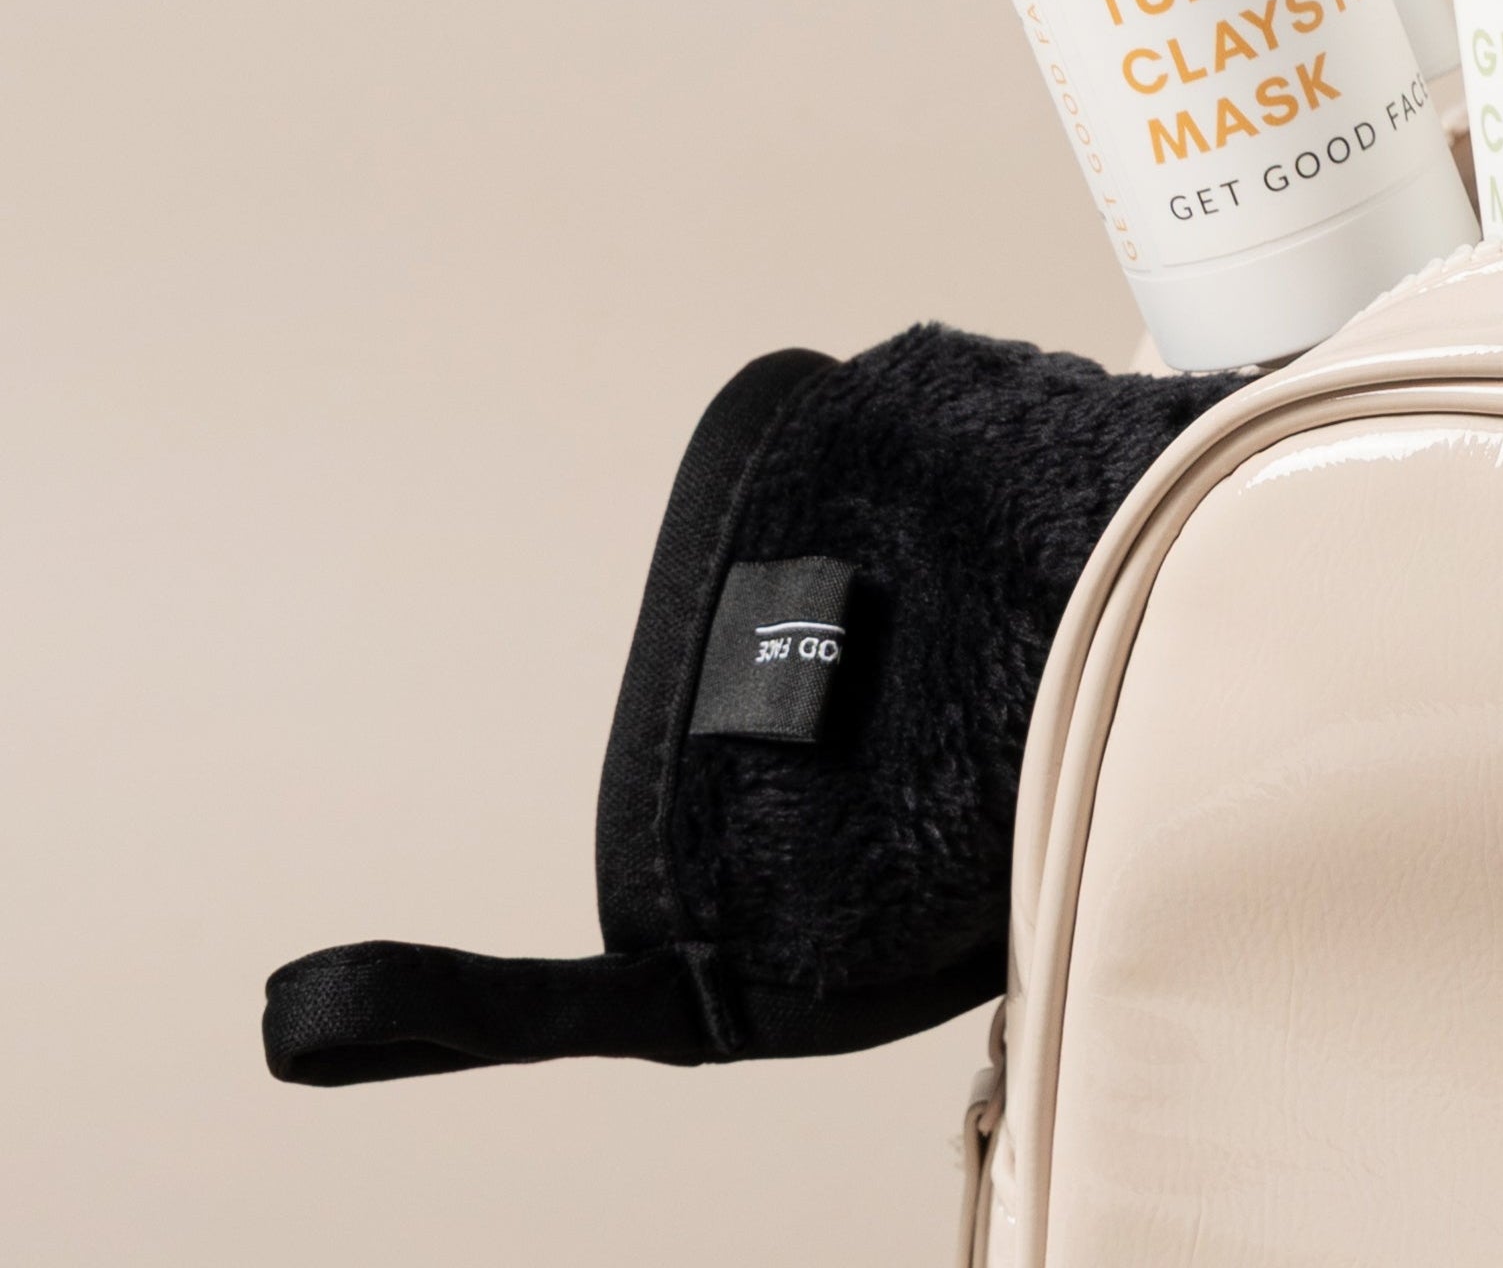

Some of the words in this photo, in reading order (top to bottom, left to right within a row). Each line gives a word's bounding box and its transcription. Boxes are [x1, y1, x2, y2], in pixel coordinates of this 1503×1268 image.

[1050, 63, 1103, 175] GOOD
[1147, 51, 1342, 165] MASK
[1169, 177, 1243, 222] GET
[1263, 121, 1377, 194] GOOD
[1103, 194, 1138, 262] GET
